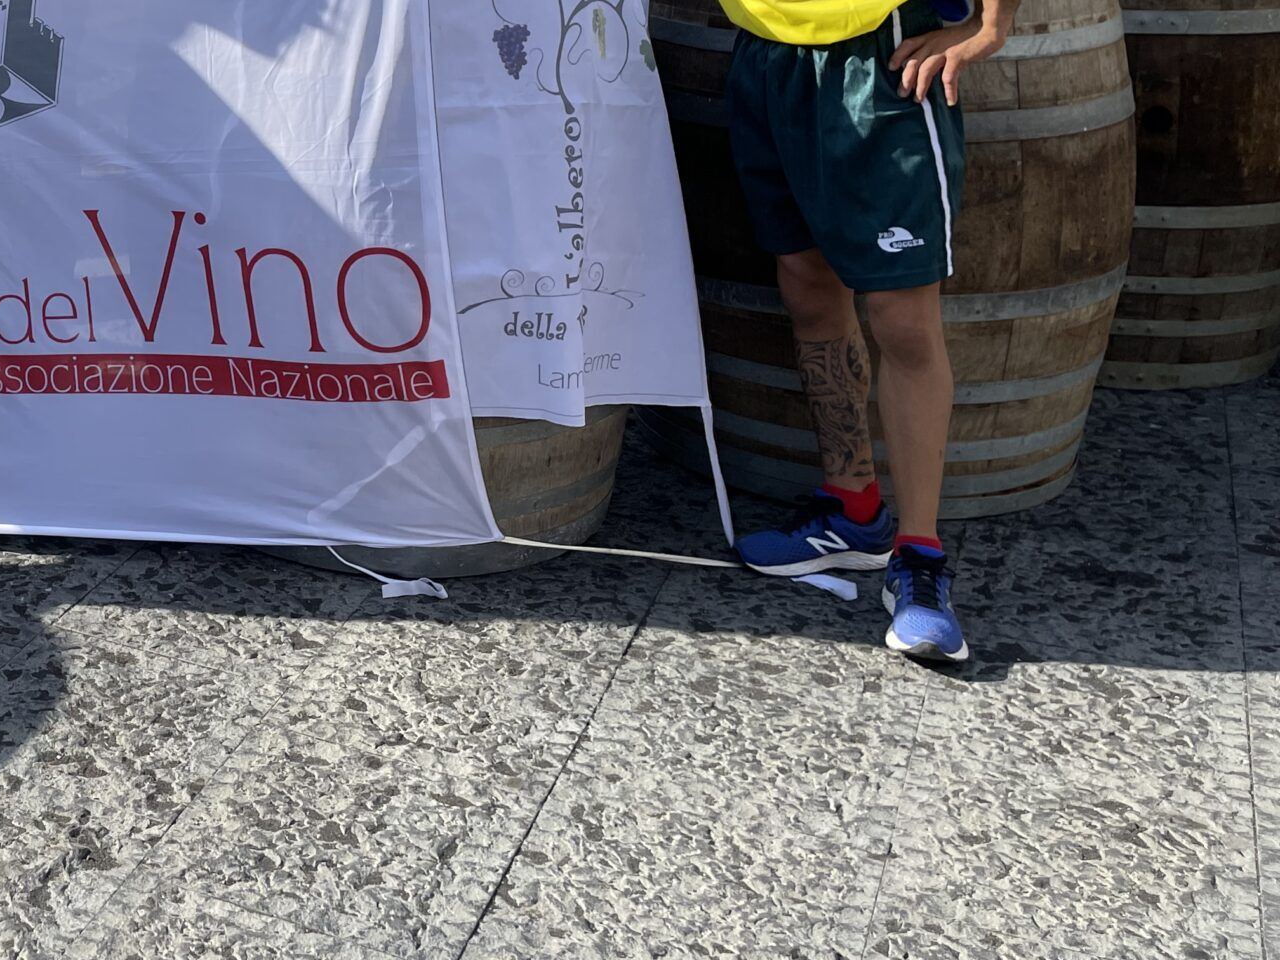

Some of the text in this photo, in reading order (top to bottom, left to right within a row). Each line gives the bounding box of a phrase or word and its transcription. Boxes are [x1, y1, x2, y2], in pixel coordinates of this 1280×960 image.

[892, 238, 925, 249] SOCCER
[83, 209, 432, 353] Vino
[503, 311, 567, 341] della
[583, 352, 622, 374] erme
[227, 358, 435, 402] Nazionale
